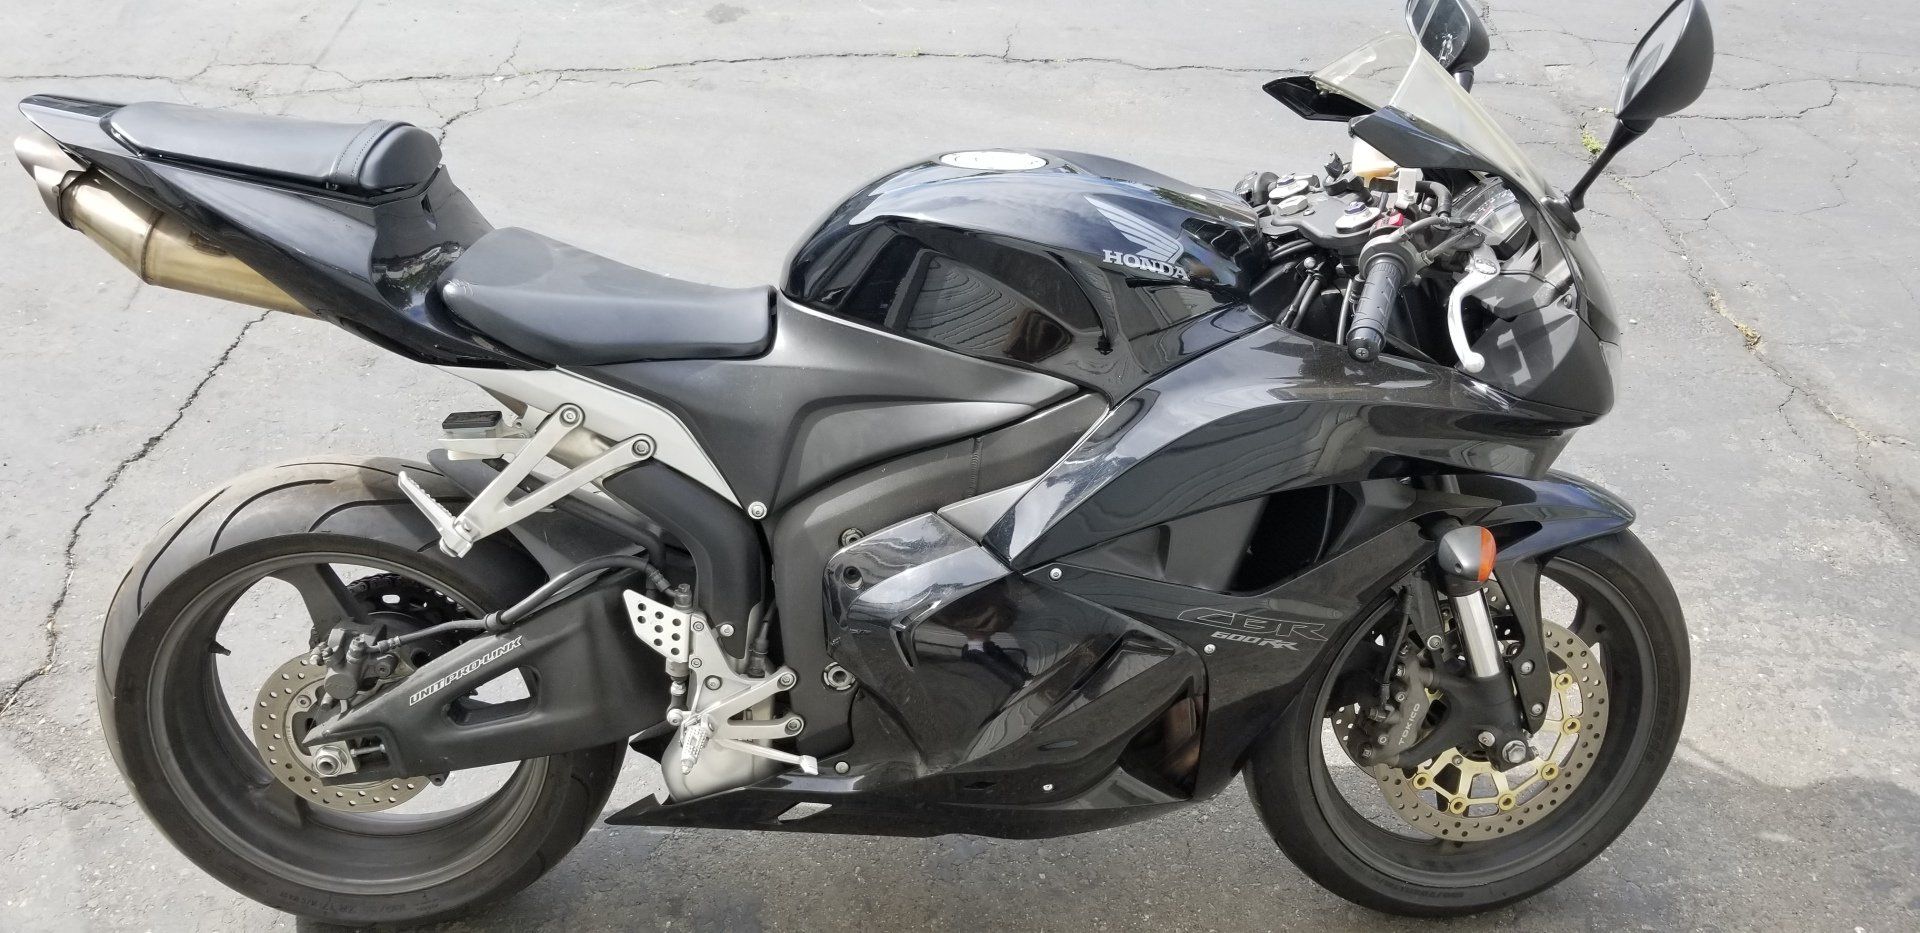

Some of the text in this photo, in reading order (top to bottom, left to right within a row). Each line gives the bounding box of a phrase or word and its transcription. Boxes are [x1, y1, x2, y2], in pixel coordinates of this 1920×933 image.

[1102, 249, 1191, 282] HONDA
[1177, 607, 1329, 642] CBR
[1210, 630, 1301, 651] 600RR
[409, 635, 523, 707] UNIT PRO-LINK
[1398, 703, 1421, 745] TOKICO
